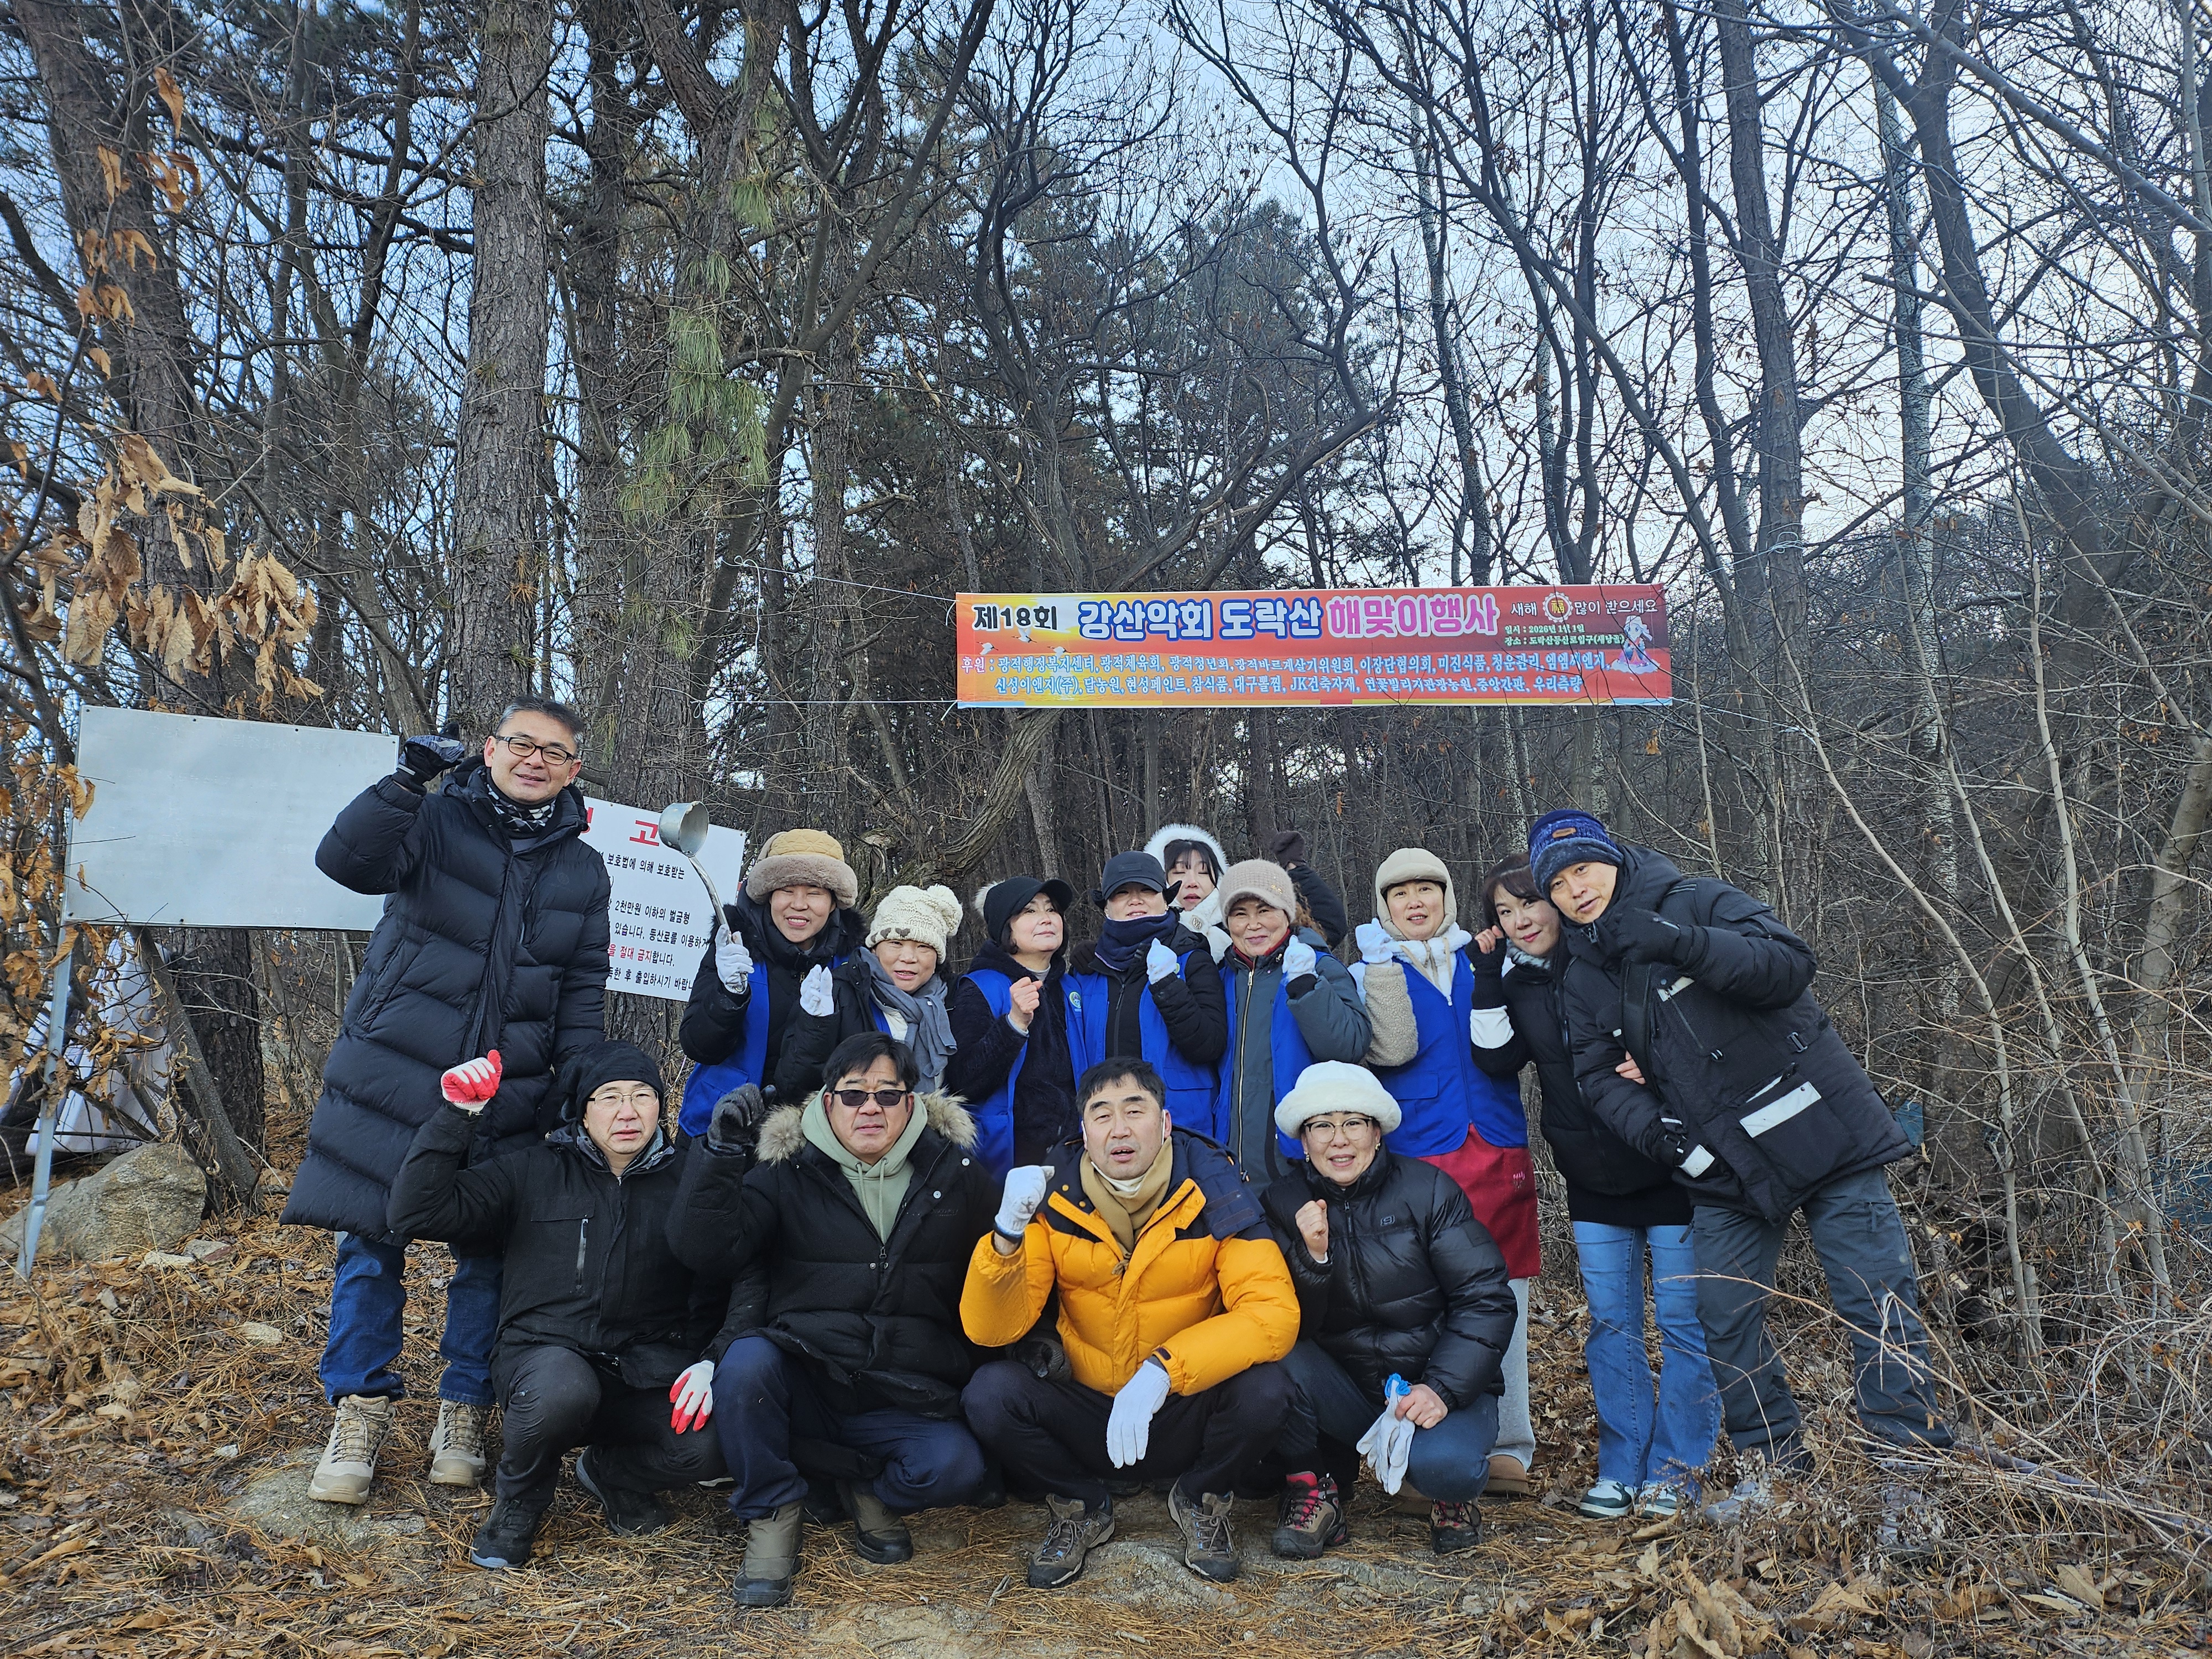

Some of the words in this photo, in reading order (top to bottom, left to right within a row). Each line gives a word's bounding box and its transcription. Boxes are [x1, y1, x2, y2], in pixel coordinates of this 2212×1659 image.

[973, 604, 1057, 630] 제18회
[1079, 601, 1211, 640] 강산악회
[1220, 599, 1321, 639] 도락산
[1327, 594, 1499, 637] 해맞이행사
[1511, 602, 1537, 616] 새해
[1551, 600, 1564, 613] 福
[1574, 600, 1600, 615] 많이
[1605, 599, 1658, 614] 받으세요
[1504, 624, 1520, 634] 일시
[1528, 624, 1556, 634] 2026년
[1572, 624, 1585, 633] 1일
[1504, 637, 1521, 646] 장소
[961, 656, 985, 674] 후원
[1533, 675, 1583, 692] 우리측량
[629, 820, 660, 846] 고
[607, 853, 637, 870] 보호법에
[639, 860, 654, 873] 의해
[657, 863, 685, 880] 보호받는
[615, 900, 641, 916] 2천만원
[645, 905, 666, 920] 이하의
[670, 910, 690, 925] 벌금형
[614, 922, 644, 940] 있습니다.
[649, 928, 677, 945] 등산로를
[620, 946, 634, 960] 절대
[638, 949, 674, 967] 금지합니다.
[624, 969, 632, 982] 후
[635, 971, 671, 988] 출입하시기
